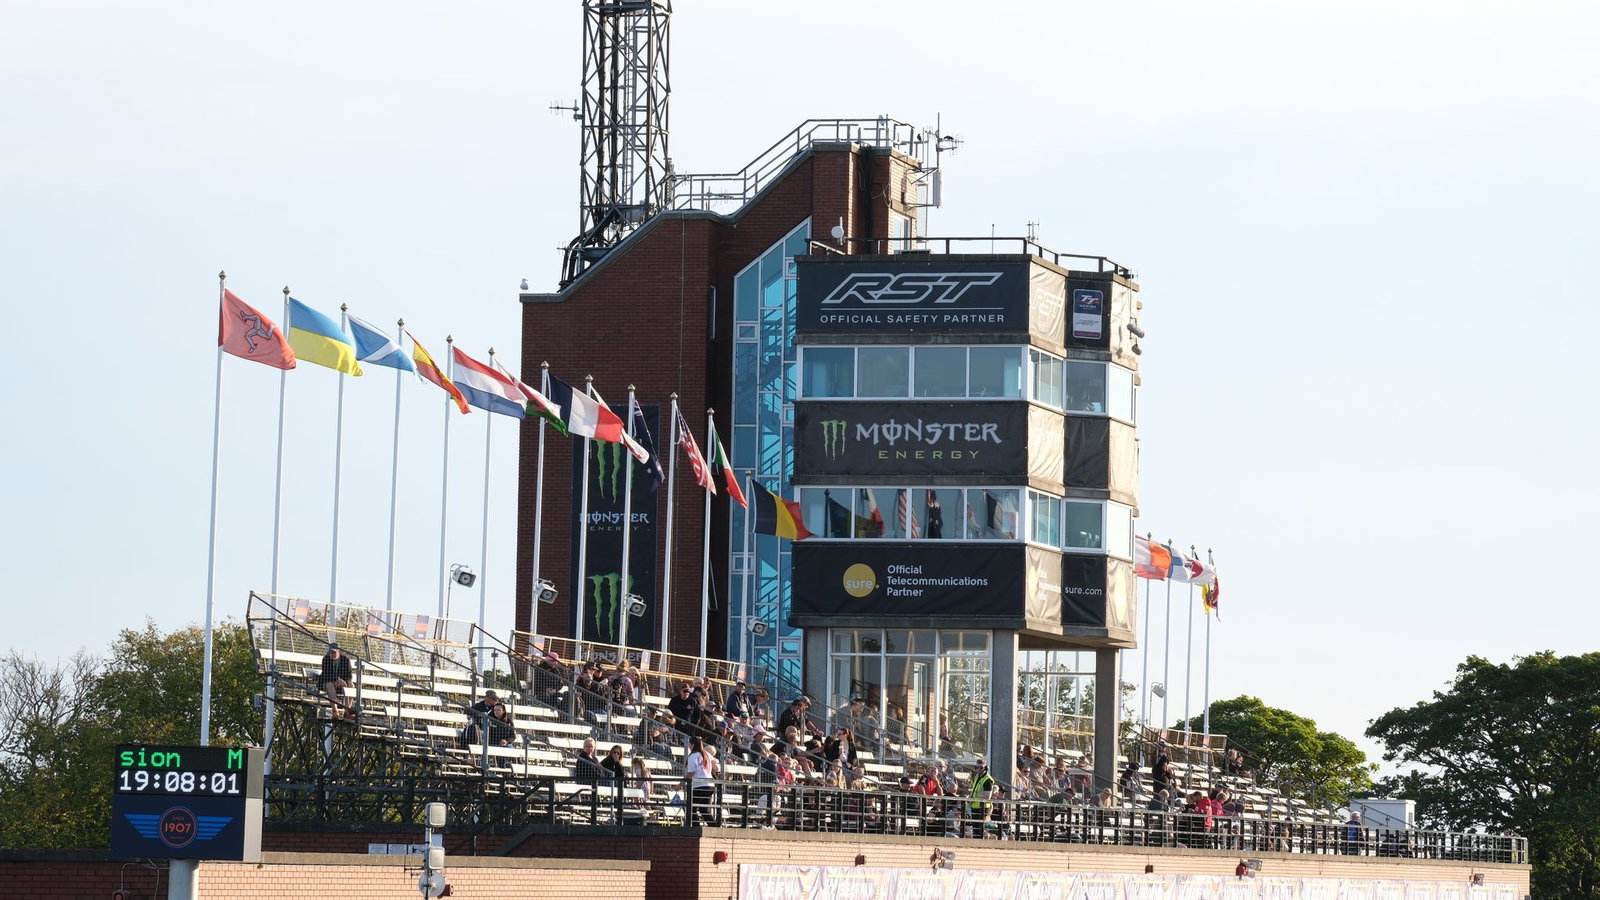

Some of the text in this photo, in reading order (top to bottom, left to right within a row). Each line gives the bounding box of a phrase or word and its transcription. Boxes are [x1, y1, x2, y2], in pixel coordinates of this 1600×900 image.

[821, 272, 1004, 303] RST
[820, 314, 1005, 324] OFFICIAL SAFETY PARTNER
[856, 418, 1003, 446] MONSTER
[878, 450, 980, 460] ENERGY
[887, 565, 922, 575] Official
[887, 576, 988, 587] Telecommunications
[887, 587, 924, 598] Partner
[1065, 586, 1102, 596] sure.com
[120, 748, 243, 769] sion M
[120, 770, 240, 794] 19:08:01
[164, 822, 191, 833] 1907
